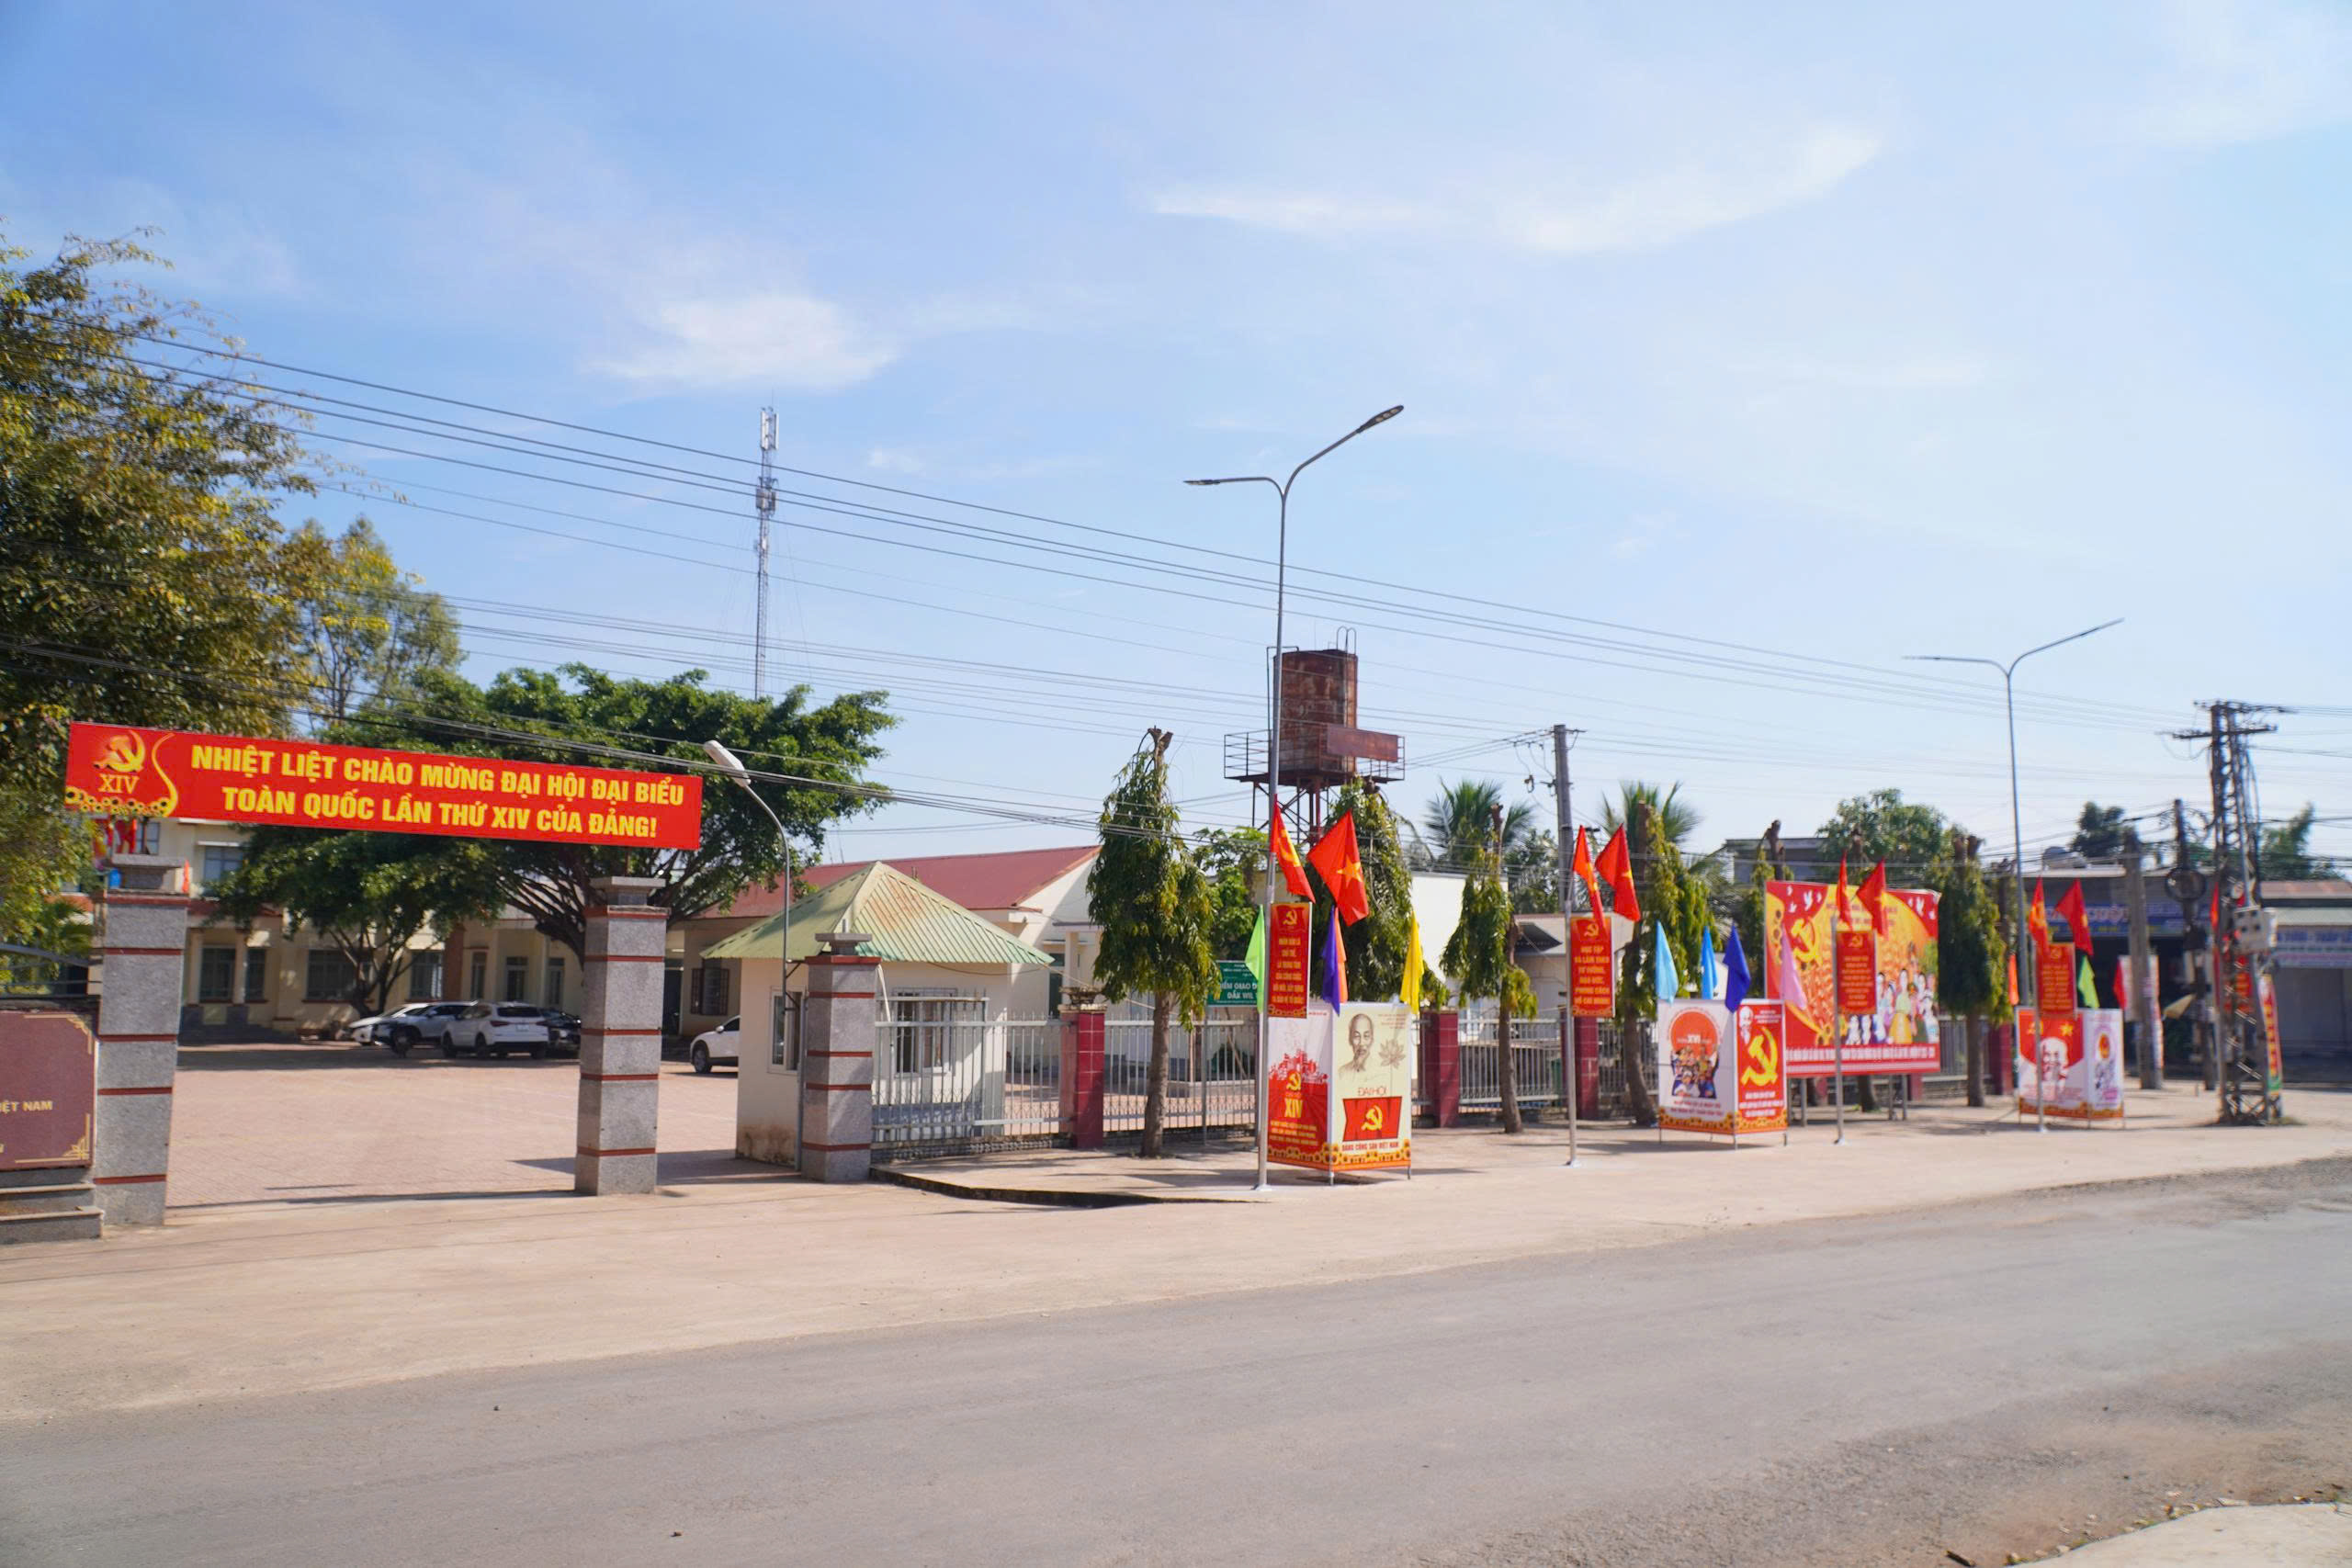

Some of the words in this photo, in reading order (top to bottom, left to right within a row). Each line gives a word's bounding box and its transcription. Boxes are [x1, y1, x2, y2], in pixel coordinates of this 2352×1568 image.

[98, 772, 141, 795] XIV
[191, 744, 275, 778] NHIỆT
[281, 750, 337, 784] LIỆT
[343, 756, 413, 785] CHÀO
[420, 761, 494, 793] MỪNG
[501, 772, 540, 799] ĐẠI
[547, 771, 585, 803] HỘI
[592, 778, 629, 806] ĐẠI
[635, 776, 684, 807] BIỂU
[221, 784, 296, 815] TOÀN
[303, 787, 375, 820] QUỐC
[381, 792, 432, 824] LẦN
[438, 800, 488, 828] THỨ
[491, 806, 530, 829] XIV
[536, 804, 582, 834] CỦA
[588, 807, 657, 838] ĐẢNG!
[22, 1100, 53, 1111] NAM
